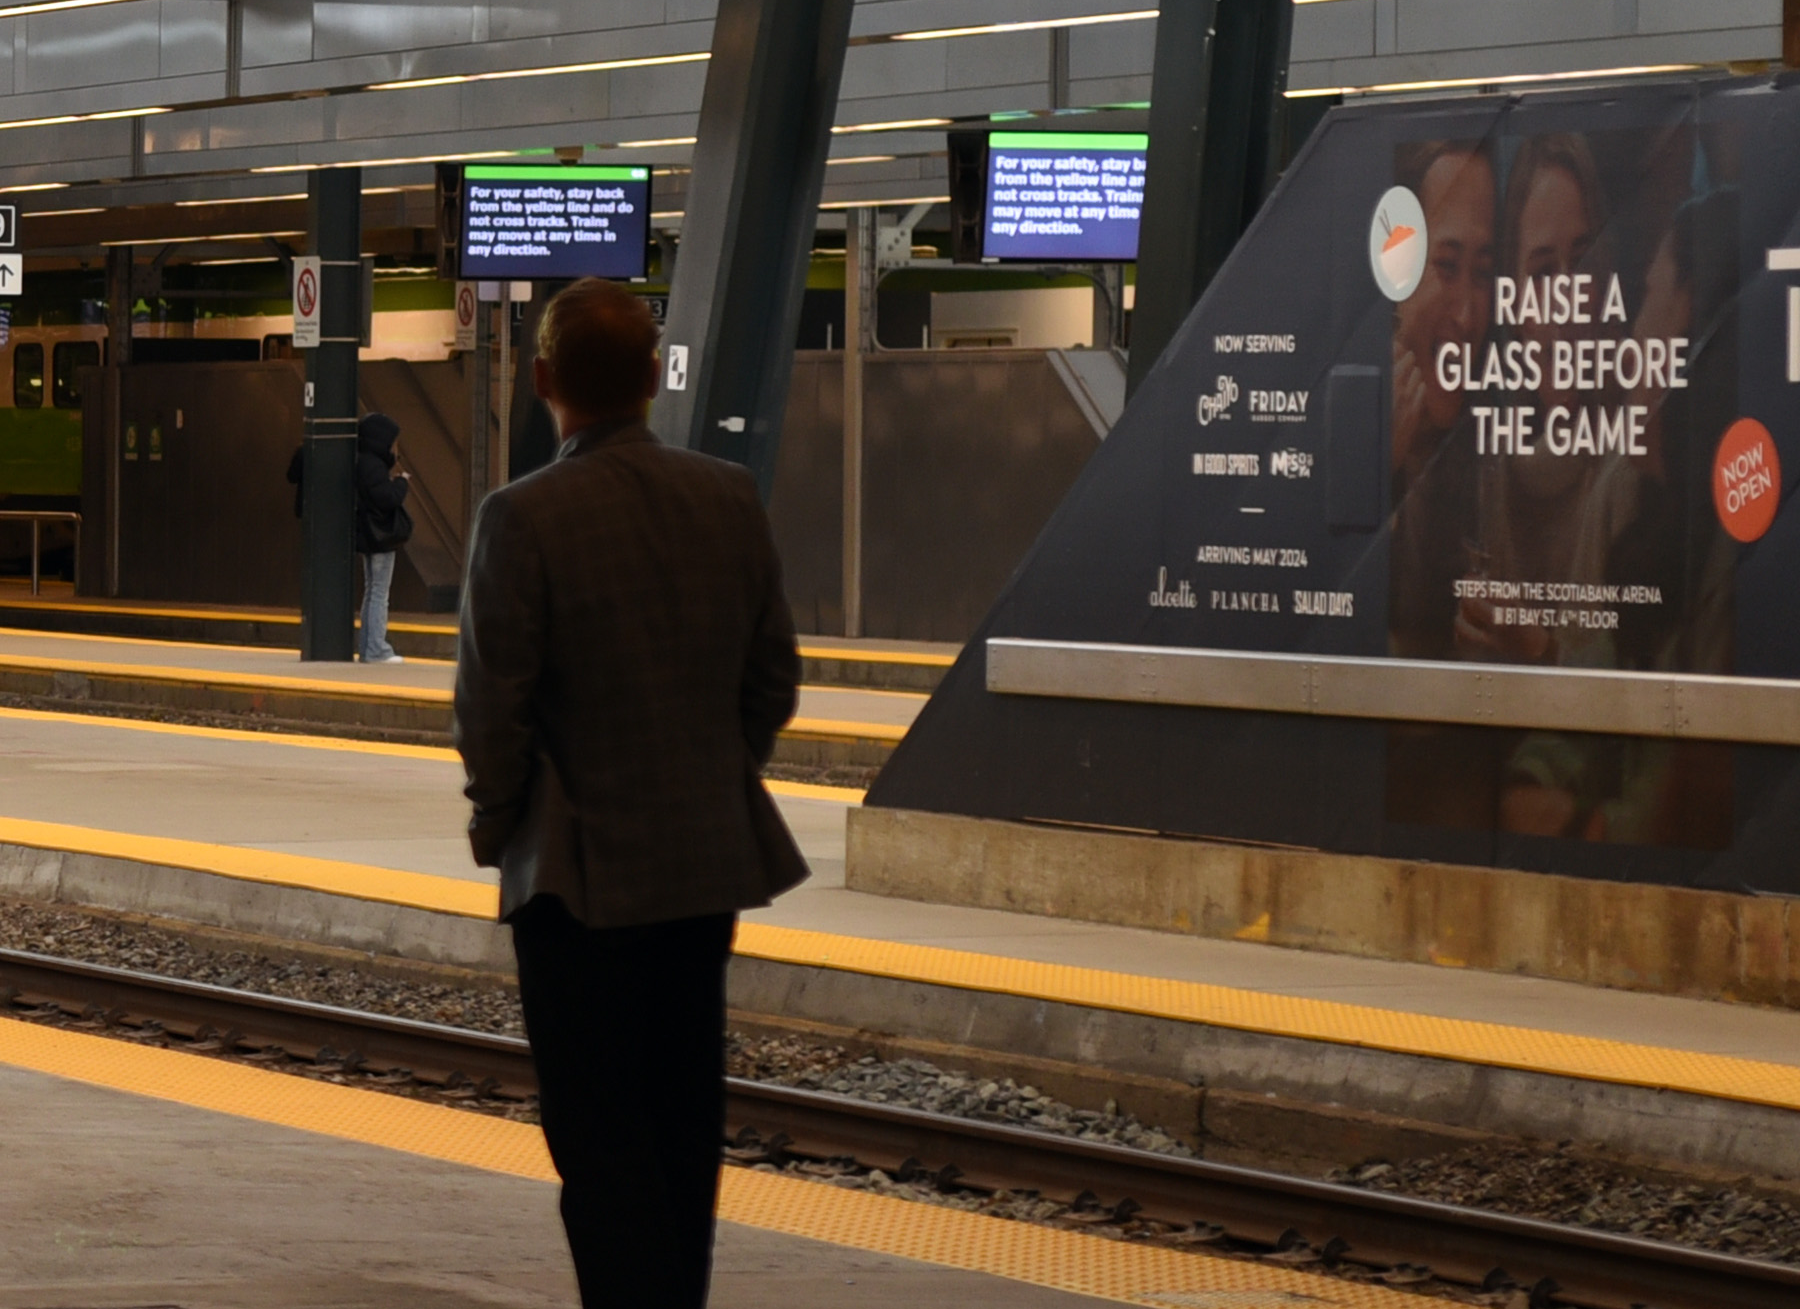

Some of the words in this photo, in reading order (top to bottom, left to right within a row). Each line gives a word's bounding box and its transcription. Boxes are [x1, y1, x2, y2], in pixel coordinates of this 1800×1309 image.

[471, 187, 491, 198] For
[494, 188, 522, 200] your
[523, 187, 564, 201] safety,
[567, 188, 593, 201] stay
[596, 188, 624, 199] back
[470, 201, 500, 212] from
[502, 202, 523, 212] the
[525, 201, 565, 215] yellow
[567, 202, 590, 213] line
[592, 202, 615, 213] and
[617, 202, 634, 213] do
[469, 216, 490, 226] not
[493, 217, 525, 227] cross
[527, 216, 568, 227] tracks.
[570, 216, 609, 228] Trains
[1496, 274, 1592, 325] RAISE
[1602, 273, 1627, 323] A
[1215, 335, 1244, 353] NOW
[1246, 334, 1296, 353] SERVING
[1436, 342, 1542, 392] GLASS
[1554, 338, 1689, 389] BEFORE
[1250, 391, 1309, 412] FRIDAY
[1472, 407, 1535, 455] THE
[1547, 406, 1647, 456] GAME
[1193, 453, 1203, 475] IN
[1228, 454, 1259, 476] SPIRITS
[1722, 443, 1764, 488] NOW
[1726, 469, 1772, 514] OPEN
[1197, 546, 1250, 564] ARRIVING
[1253, 548, 1278, 566] MAY
[1279, 549, 1308, 567] 2024
[1211, 590, 1280, 612] PLANCHA
[1454, 580, 1487, 597] STEPS
[1489, 581, 1521, 598] FROM
[1523, 582, 1544, 600] THE
[1547, 584, 1620, 602] SCOTIABANK
[1622, 587, 1663, 604] ARENA
[1294, 590, 1326, 614] SALAD
[1328, 592, 1354, 617] DAYS
[1505, 610, 1517, 625] 81
[1519, 609, 1541, 626] BAY
[1543, 611, 1558, 627] ST.
[1579, 611, 1618, 629] FLOOR
